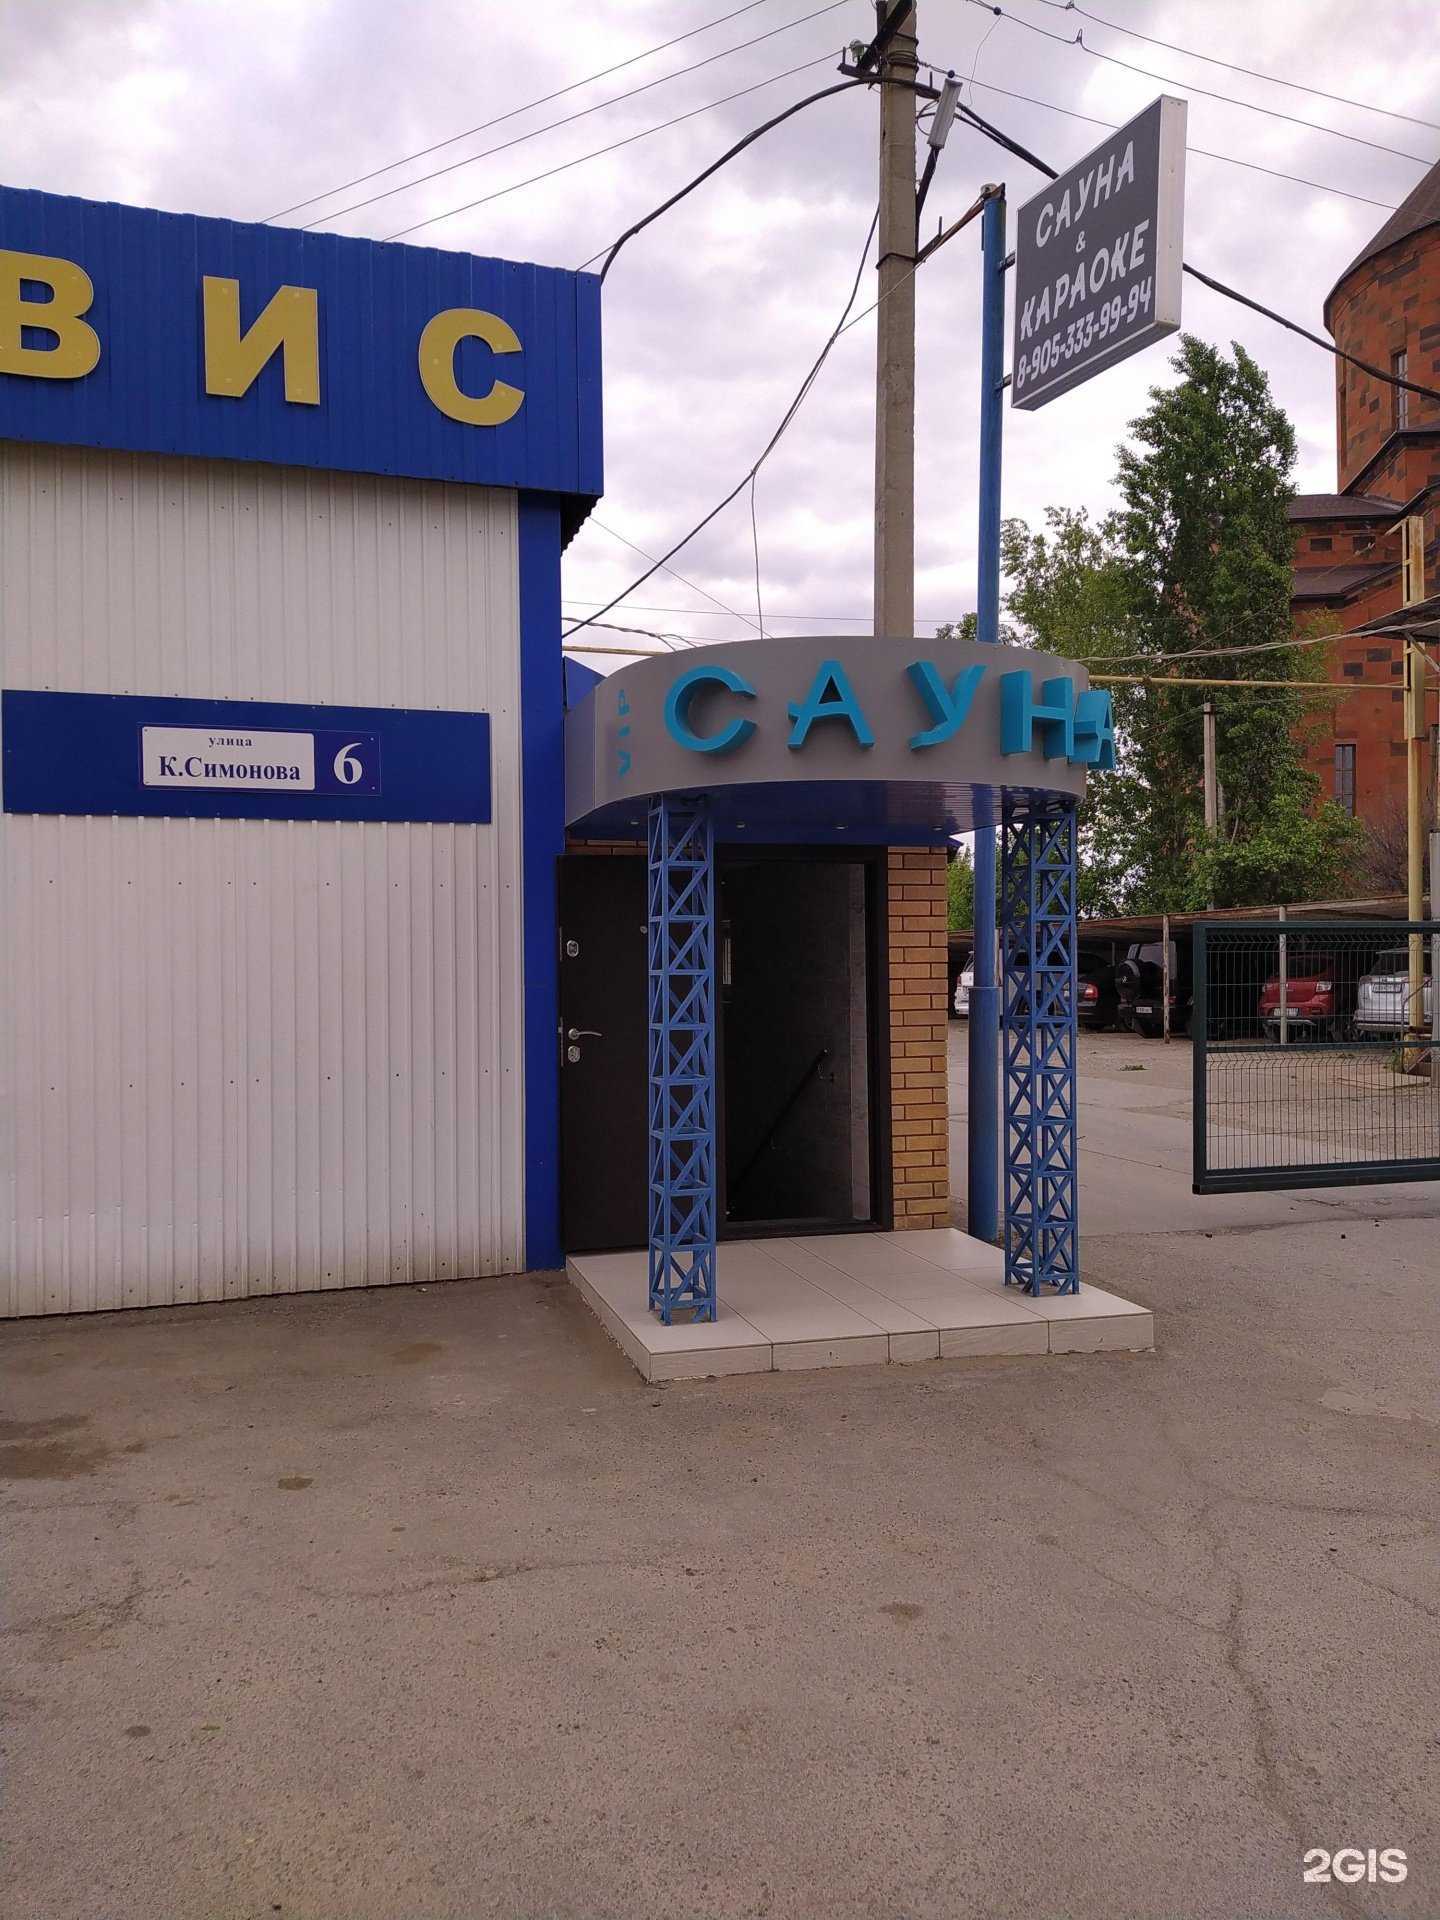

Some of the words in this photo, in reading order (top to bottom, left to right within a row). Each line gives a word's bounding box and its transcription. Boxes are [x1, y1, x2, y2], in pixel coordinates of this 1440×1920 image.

[1035, 140, 1135, 248] САУНА
[1075, 230, 1087, 253] &
[1016, 276, 1153, 389] 8-905-333-99-94
[1020, 218, 1150, 342] КАРАОКЕ
[158, 755, 301, 781] К.Симонова
[333, 742, 363, 785] 6
[208, 735, 253, 748] улица
[663, 659, 1116, 770] САУНА
